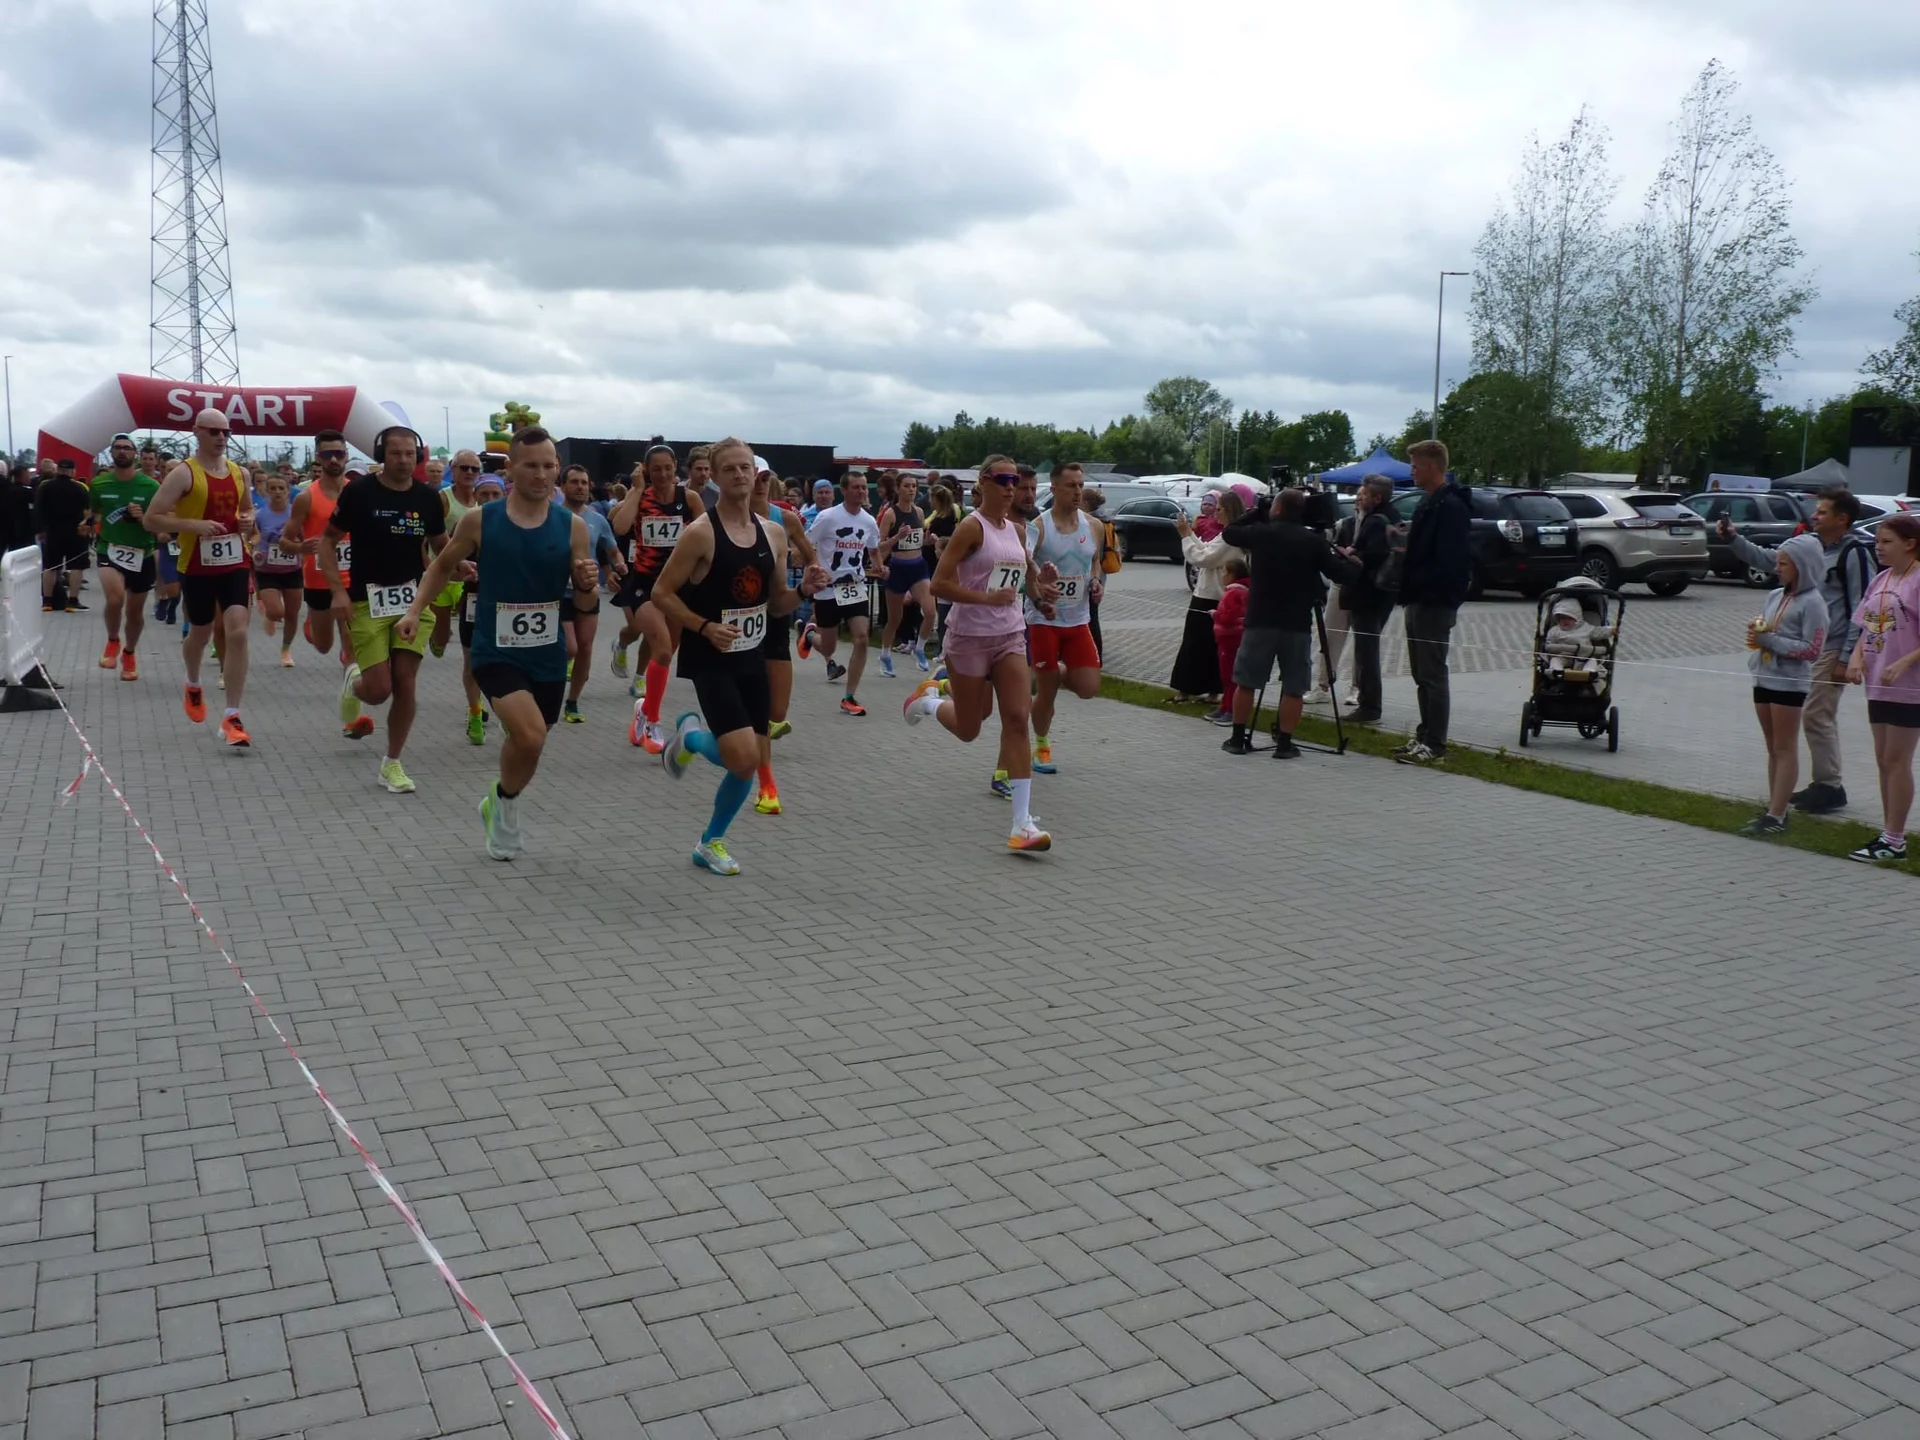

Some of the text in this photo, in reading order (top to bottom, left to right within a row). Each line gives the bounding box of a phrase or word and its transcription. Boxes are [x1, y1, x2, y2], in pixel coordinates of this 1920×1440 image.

[167, 388, 313, 427] START
[646, 522, 680, 538] 147
[115, 549, 135, 564] 22
[211, 541, 233, 558] 81
[1000, 568, 1021, 588] 78
[373, 586, 415, 608] 158
[841, 586, 858, 599] 35
[512, 612, 547, 636] 63
